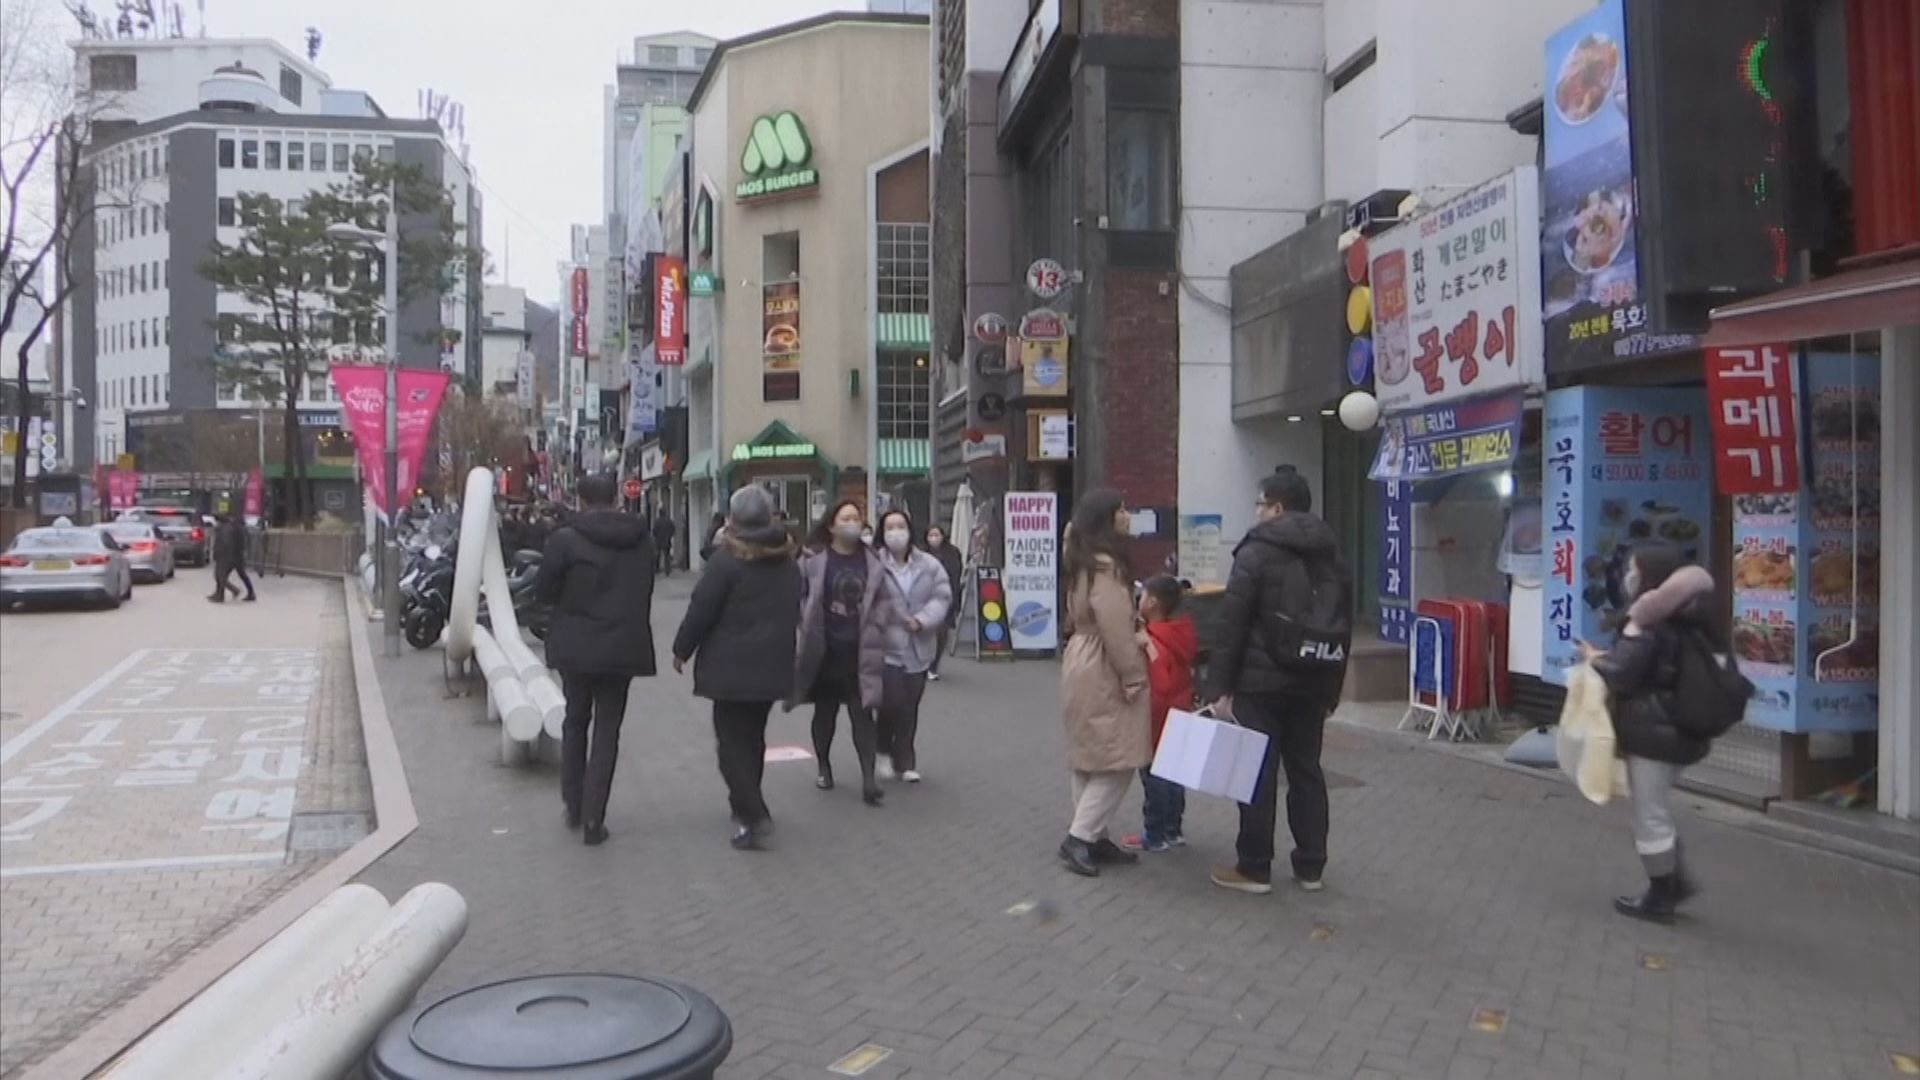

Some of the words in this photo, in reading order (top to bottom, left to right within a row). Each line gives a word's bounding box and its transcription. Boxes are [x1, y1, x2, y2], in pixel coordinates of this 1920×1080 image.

[736, 179, 764, 197] MOS
[765, 169, 815, 192] BURGER
[1035, 271, 1059, 289] 13
[1440, 257, 1508, 302] たまごやき
[1413, 305, 1515, 395] 골뱅이
[1599, 411, 1692, 459] 활어
[1718, 346, 1784, 488] 과메기
[1008, 497, 1053, 513] HAPPY
[1011, 515, 1051, 532] HOUR
[1386, 480, 1401, 596] 비뇨기과
[1548, 437, 1577, 642] 묵호회집
[1299, 640, 1344, 661] FILA
